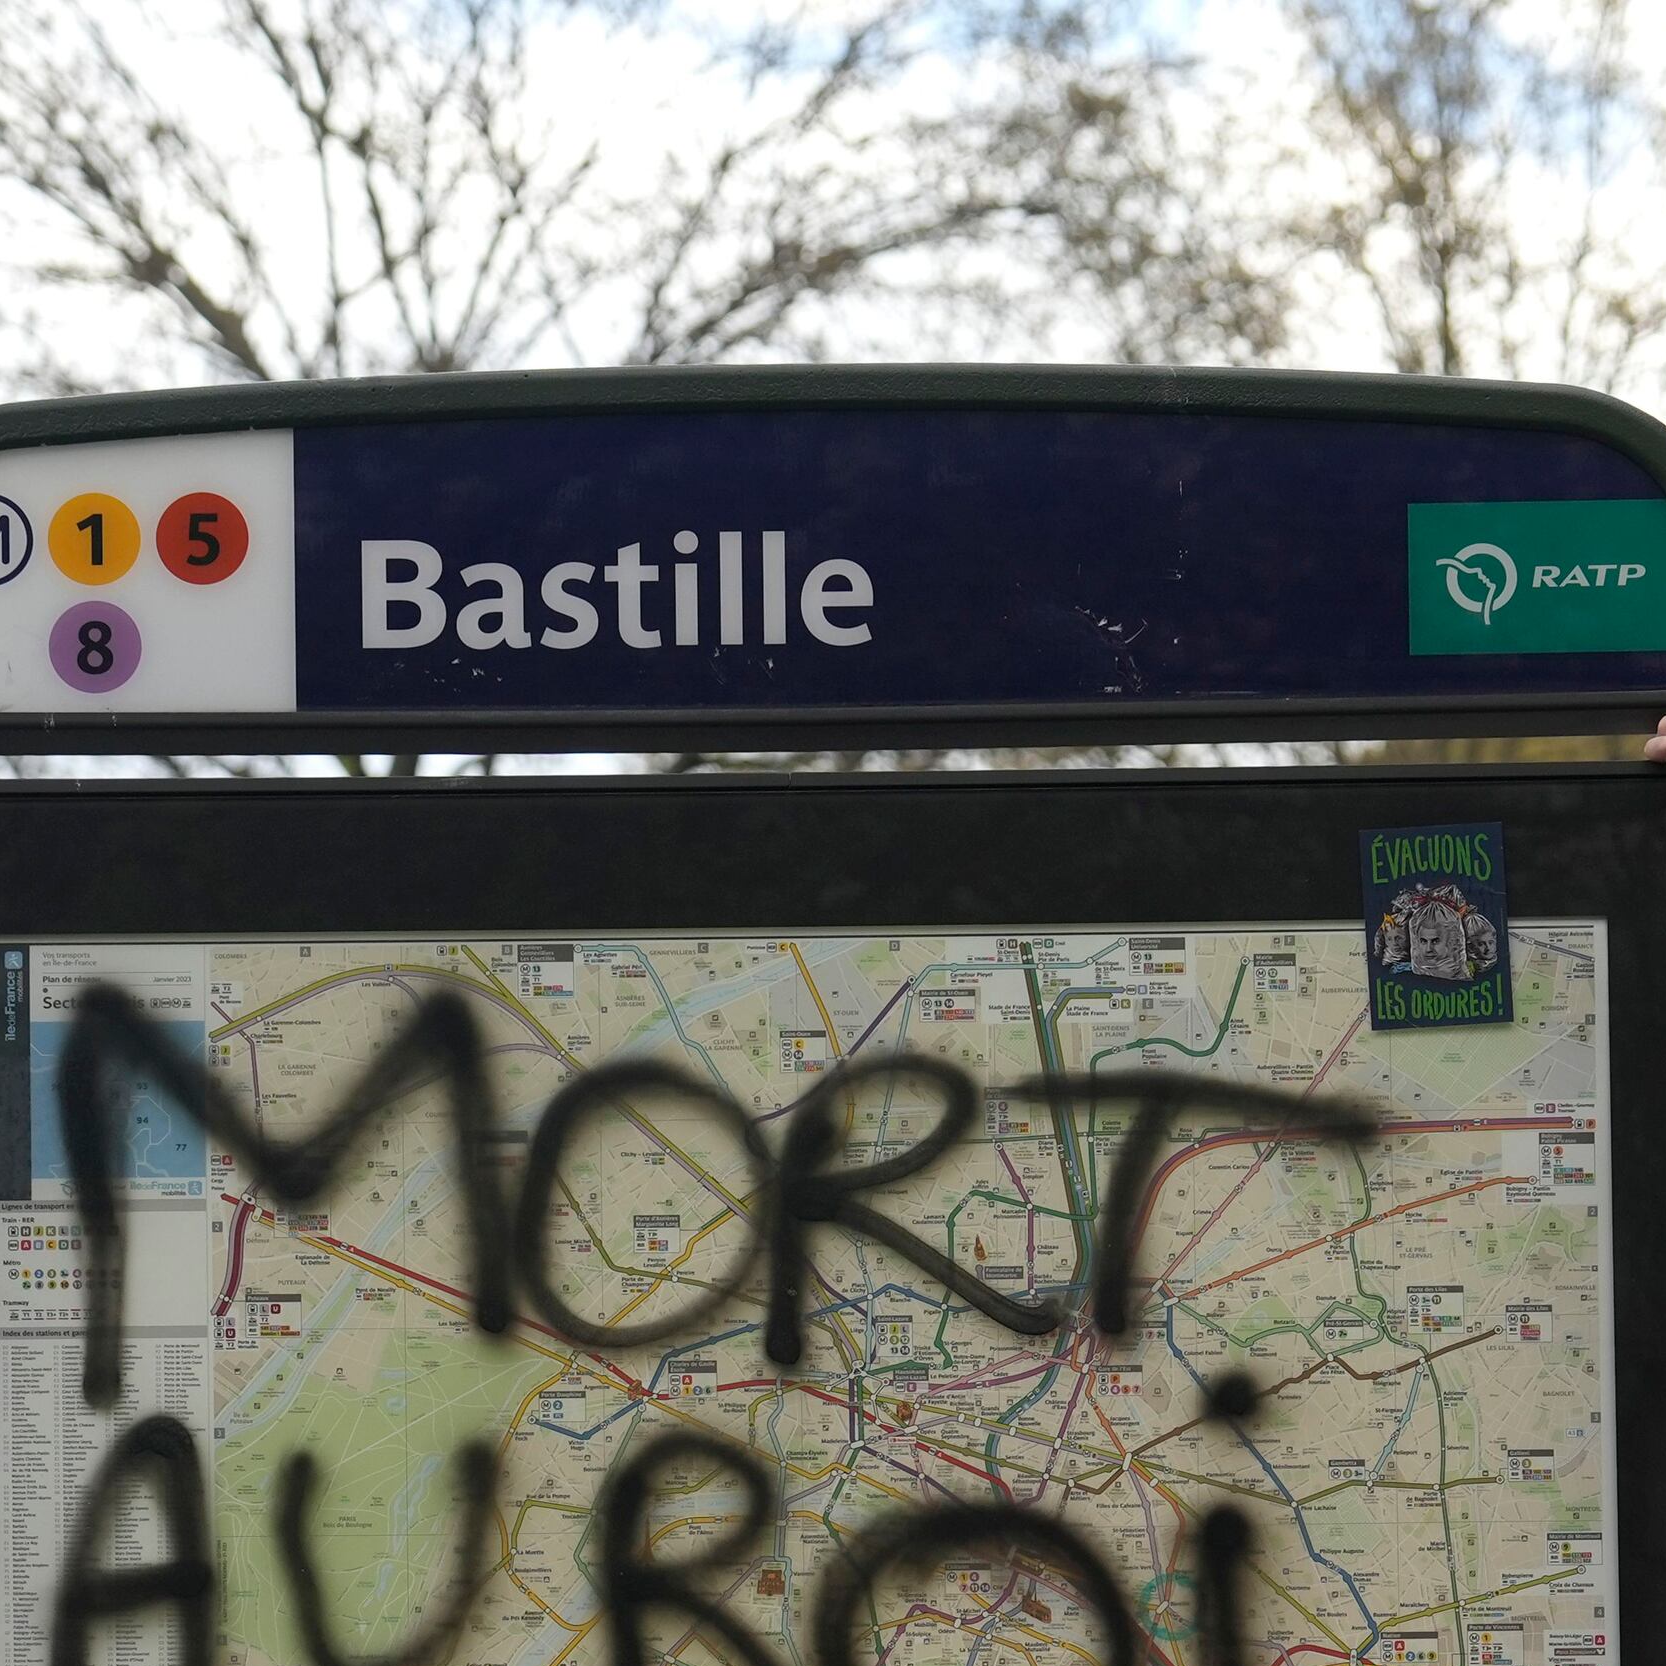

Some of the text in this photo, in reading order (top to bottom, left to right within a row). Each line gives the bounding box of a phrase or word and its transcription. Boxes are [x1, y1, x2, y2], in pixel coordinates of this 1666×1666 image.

[76, 513, 104, 567] 1
[185, 512, 221, 567] 5
[1531, 563, 1647, 588] RATP
[360, 529, 875, 651] Bastille
[76, 620, 114, 675] 8
[1371, 832, 1493, 885] ÉVACUONS
[42, 975, 59, 984] Plan
[61, 975, 72, 984] de
[1376, 977, 1407, 1021] LES
[1412, 980, 1494, 1021] ORDURES
[136, 1116, 149, 1125] 94
[175, 1143, 187, 1152] 77
[53, 983, 1393, 1405] MORT
[1, 1202, 23, 1212] Lignes
[2, 1258, 21, 1267] Métro
[2, 1299, 29, 1309] Tramway
[2, 1328, 20, 1339] Index
[34, 1328, 60, 1338] stations
